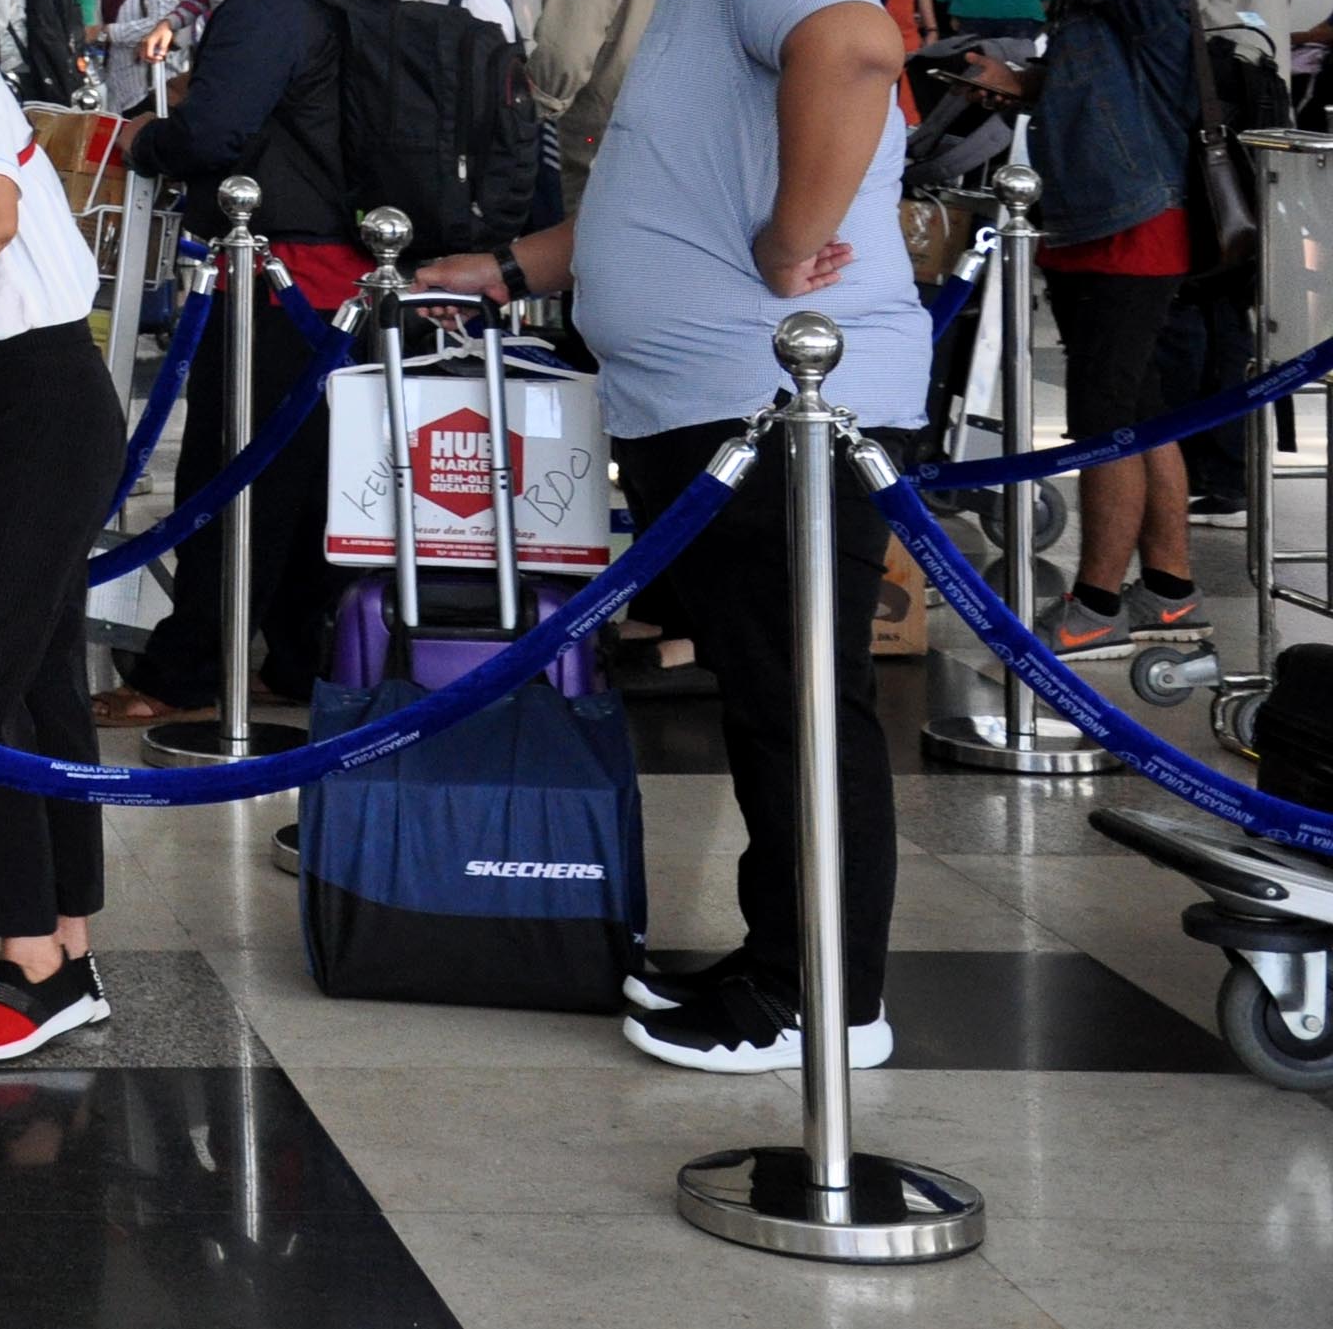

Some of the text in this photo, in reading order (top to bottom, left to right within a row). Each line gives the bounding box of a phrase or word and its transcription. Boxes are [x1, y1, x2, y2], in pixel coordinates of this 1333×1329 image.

[430, 458, 492, 473] MARKE
[430, 473, 492, 484] OLEH-OLE
[921, 551, 950, 583] PURA
[945, 581, 993, 631] ANGKASA
[1027, 668, 1059, 697] PURA
[1056, 693, 1111, 738] ANGKASA
[1158, 769, 1194, 795] PURA
[1192, 792, 1256, 824] ANGKASA
[465, 860, 606, 880] SKECHERS
